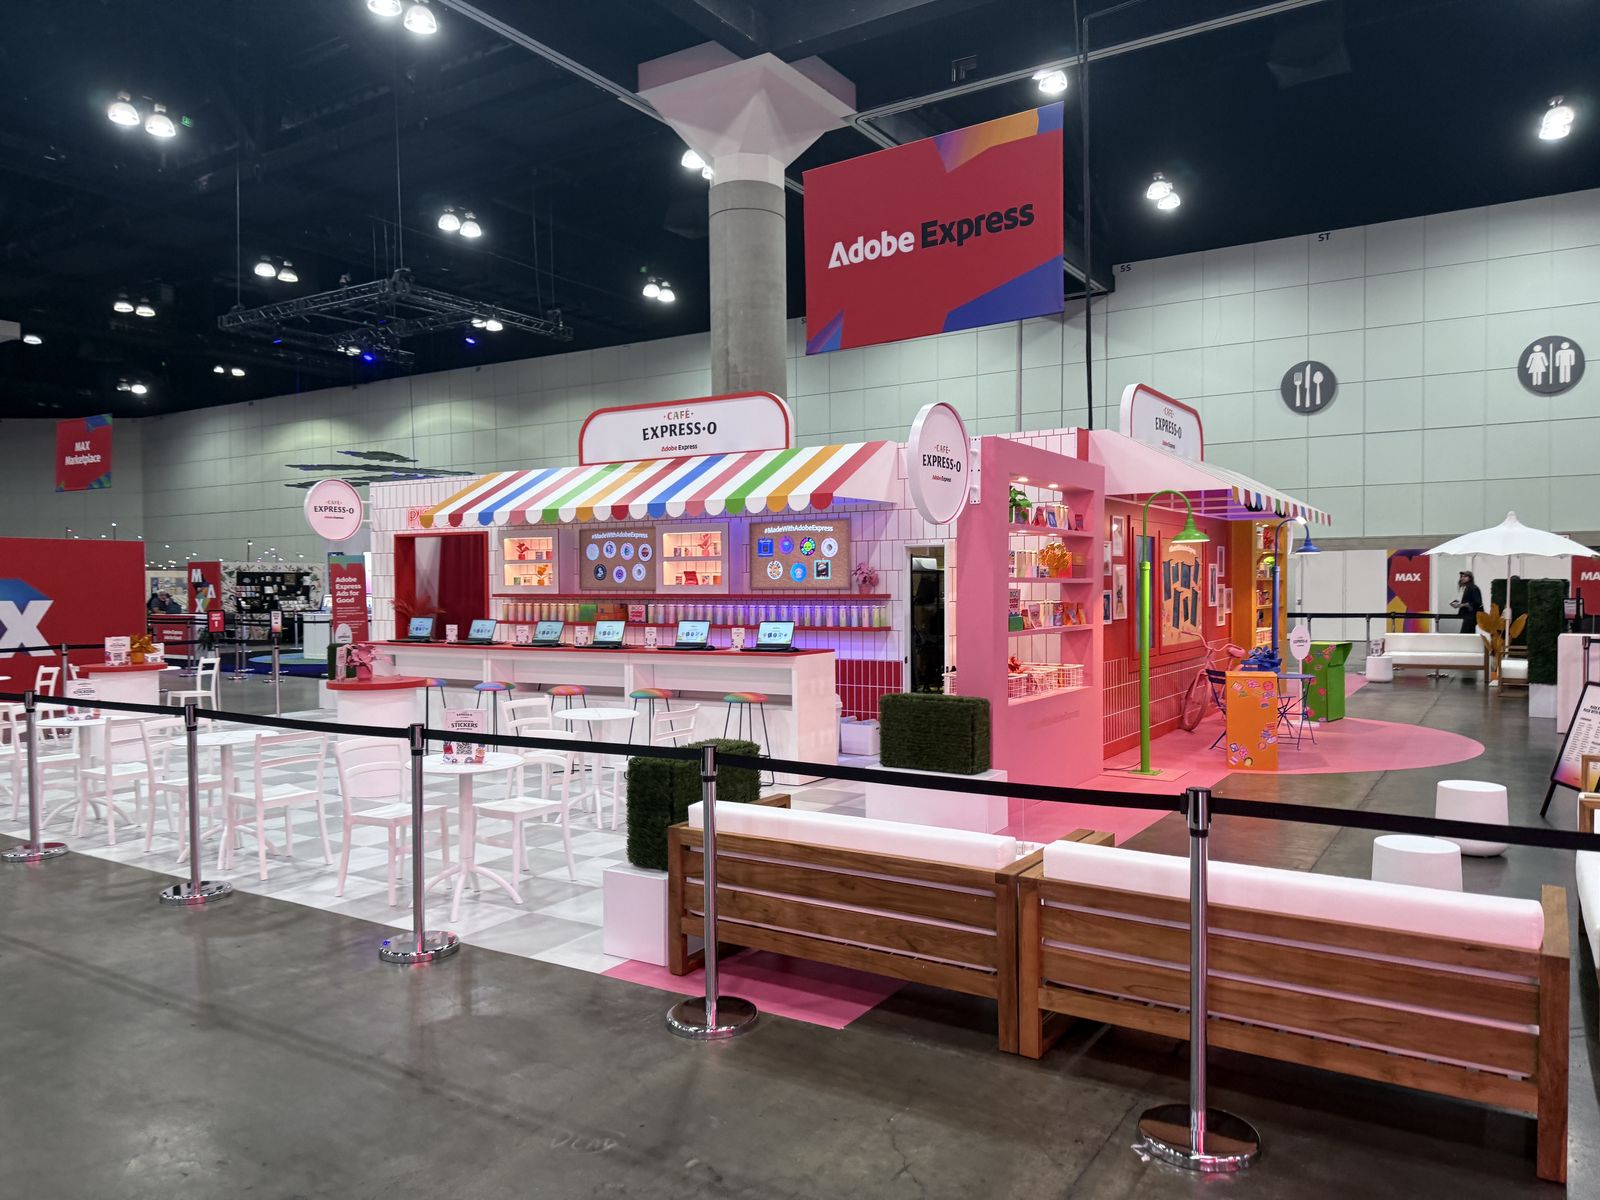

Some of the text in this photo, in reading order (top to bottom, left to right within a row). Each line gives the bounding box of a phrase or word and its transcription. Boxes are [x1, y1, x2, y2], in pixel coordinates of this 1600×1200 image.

[828, 203, 1035, 269] Adobe Express
[1317, 232, 1331, 242] ST
[1120, 264, 1132, 272] SS
[667, 408, 690, 420] CAFÉ
[74, 441, 91, 452] MAX
[65, 454, 102, 466] Marketplace
[764, 524, 834, 534] #MadeWithAdobeExpress
[1395, 572, 1421, 582] MAX
